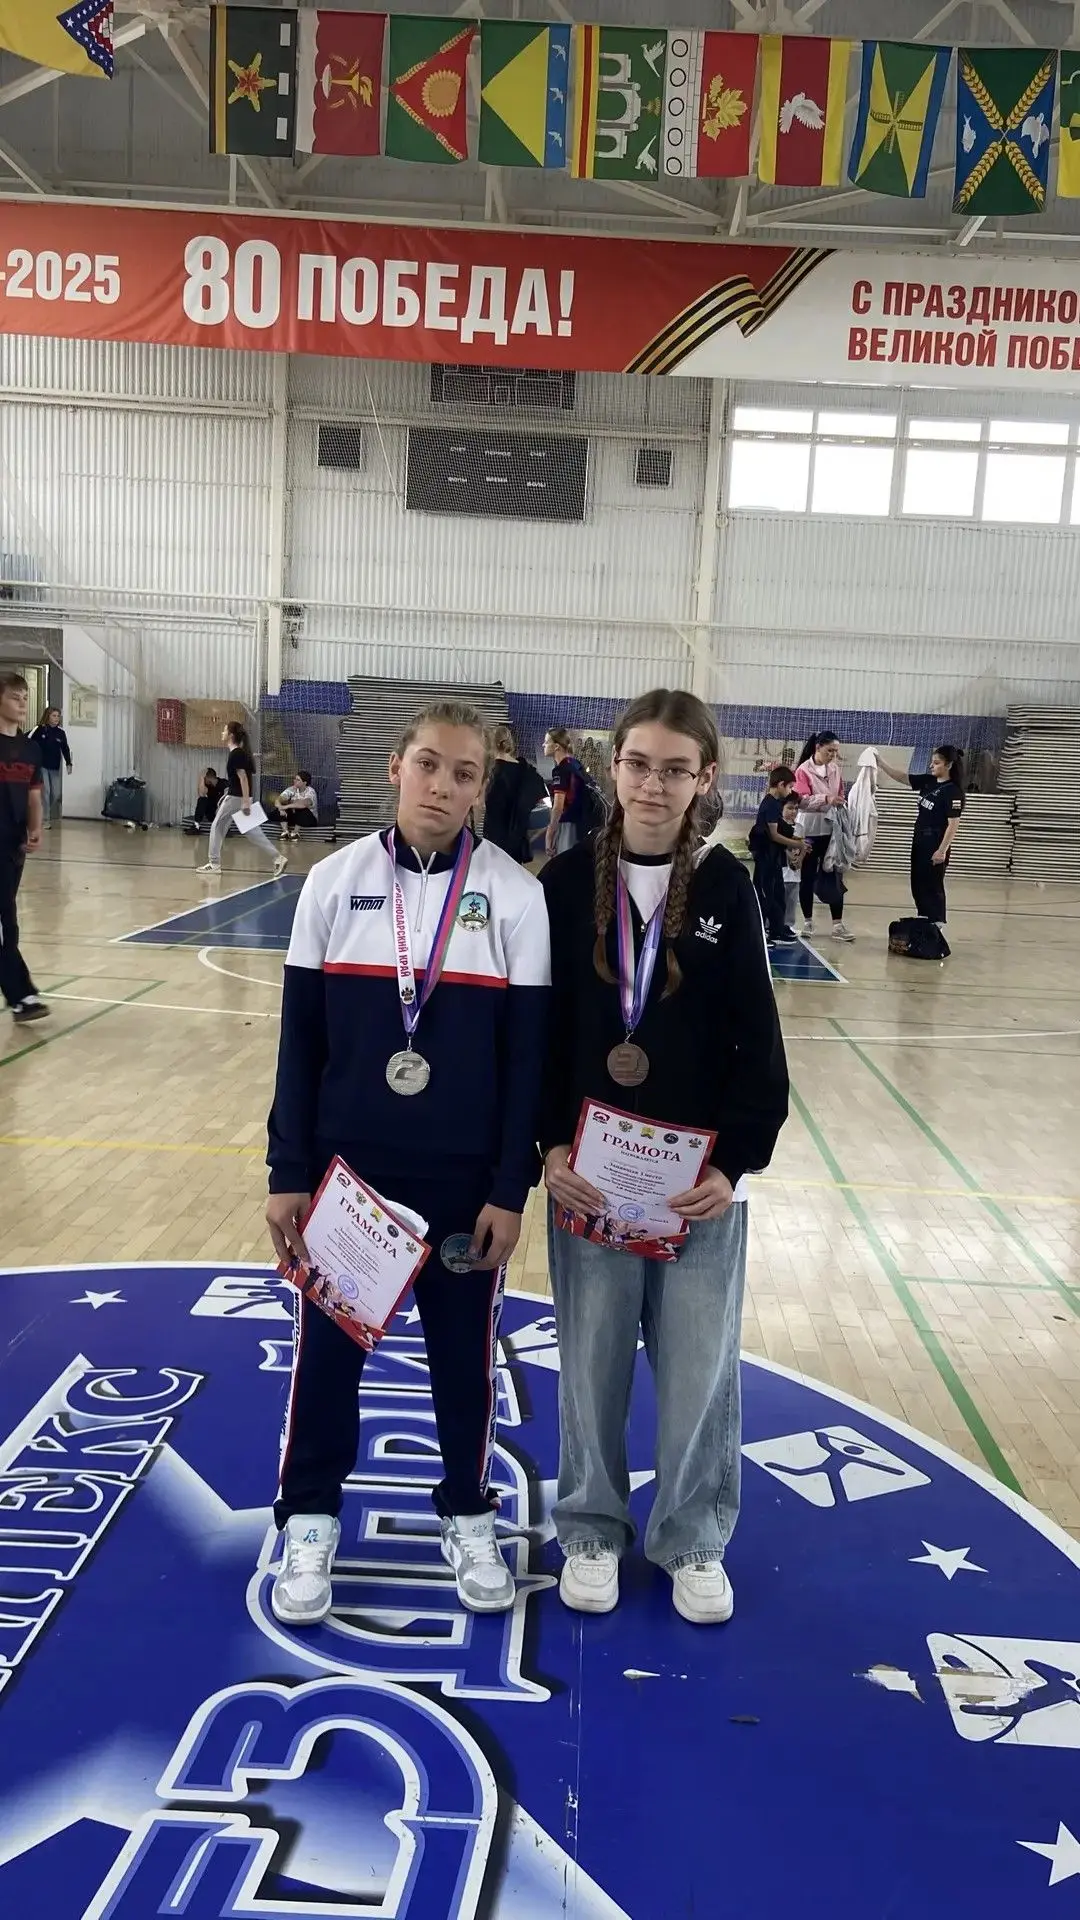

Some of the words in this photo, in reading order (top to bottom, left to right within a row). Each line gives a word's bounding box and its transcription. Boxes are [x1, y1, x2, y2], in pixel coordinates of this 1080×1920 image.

[183, 235, 282, 329] 80
[297, 252, 575, 345] ПОБЕДА!
[852, 280, 872, 315] С
[883, 281, 1080, 326] ПРАЗДНИКО
[848, 327, 997, 368] ВЕЛИКОЙ
[394, 883, 409, 953] КРАСНОДАРСКИЙ
[694, 930, 719, 945] adidas
[400, 954, 412, 978] КРАЙ
[601, 1132, 682, 1163] ГРАМОТА
[338, 1195, 399, 1260] ГРАМОТА
